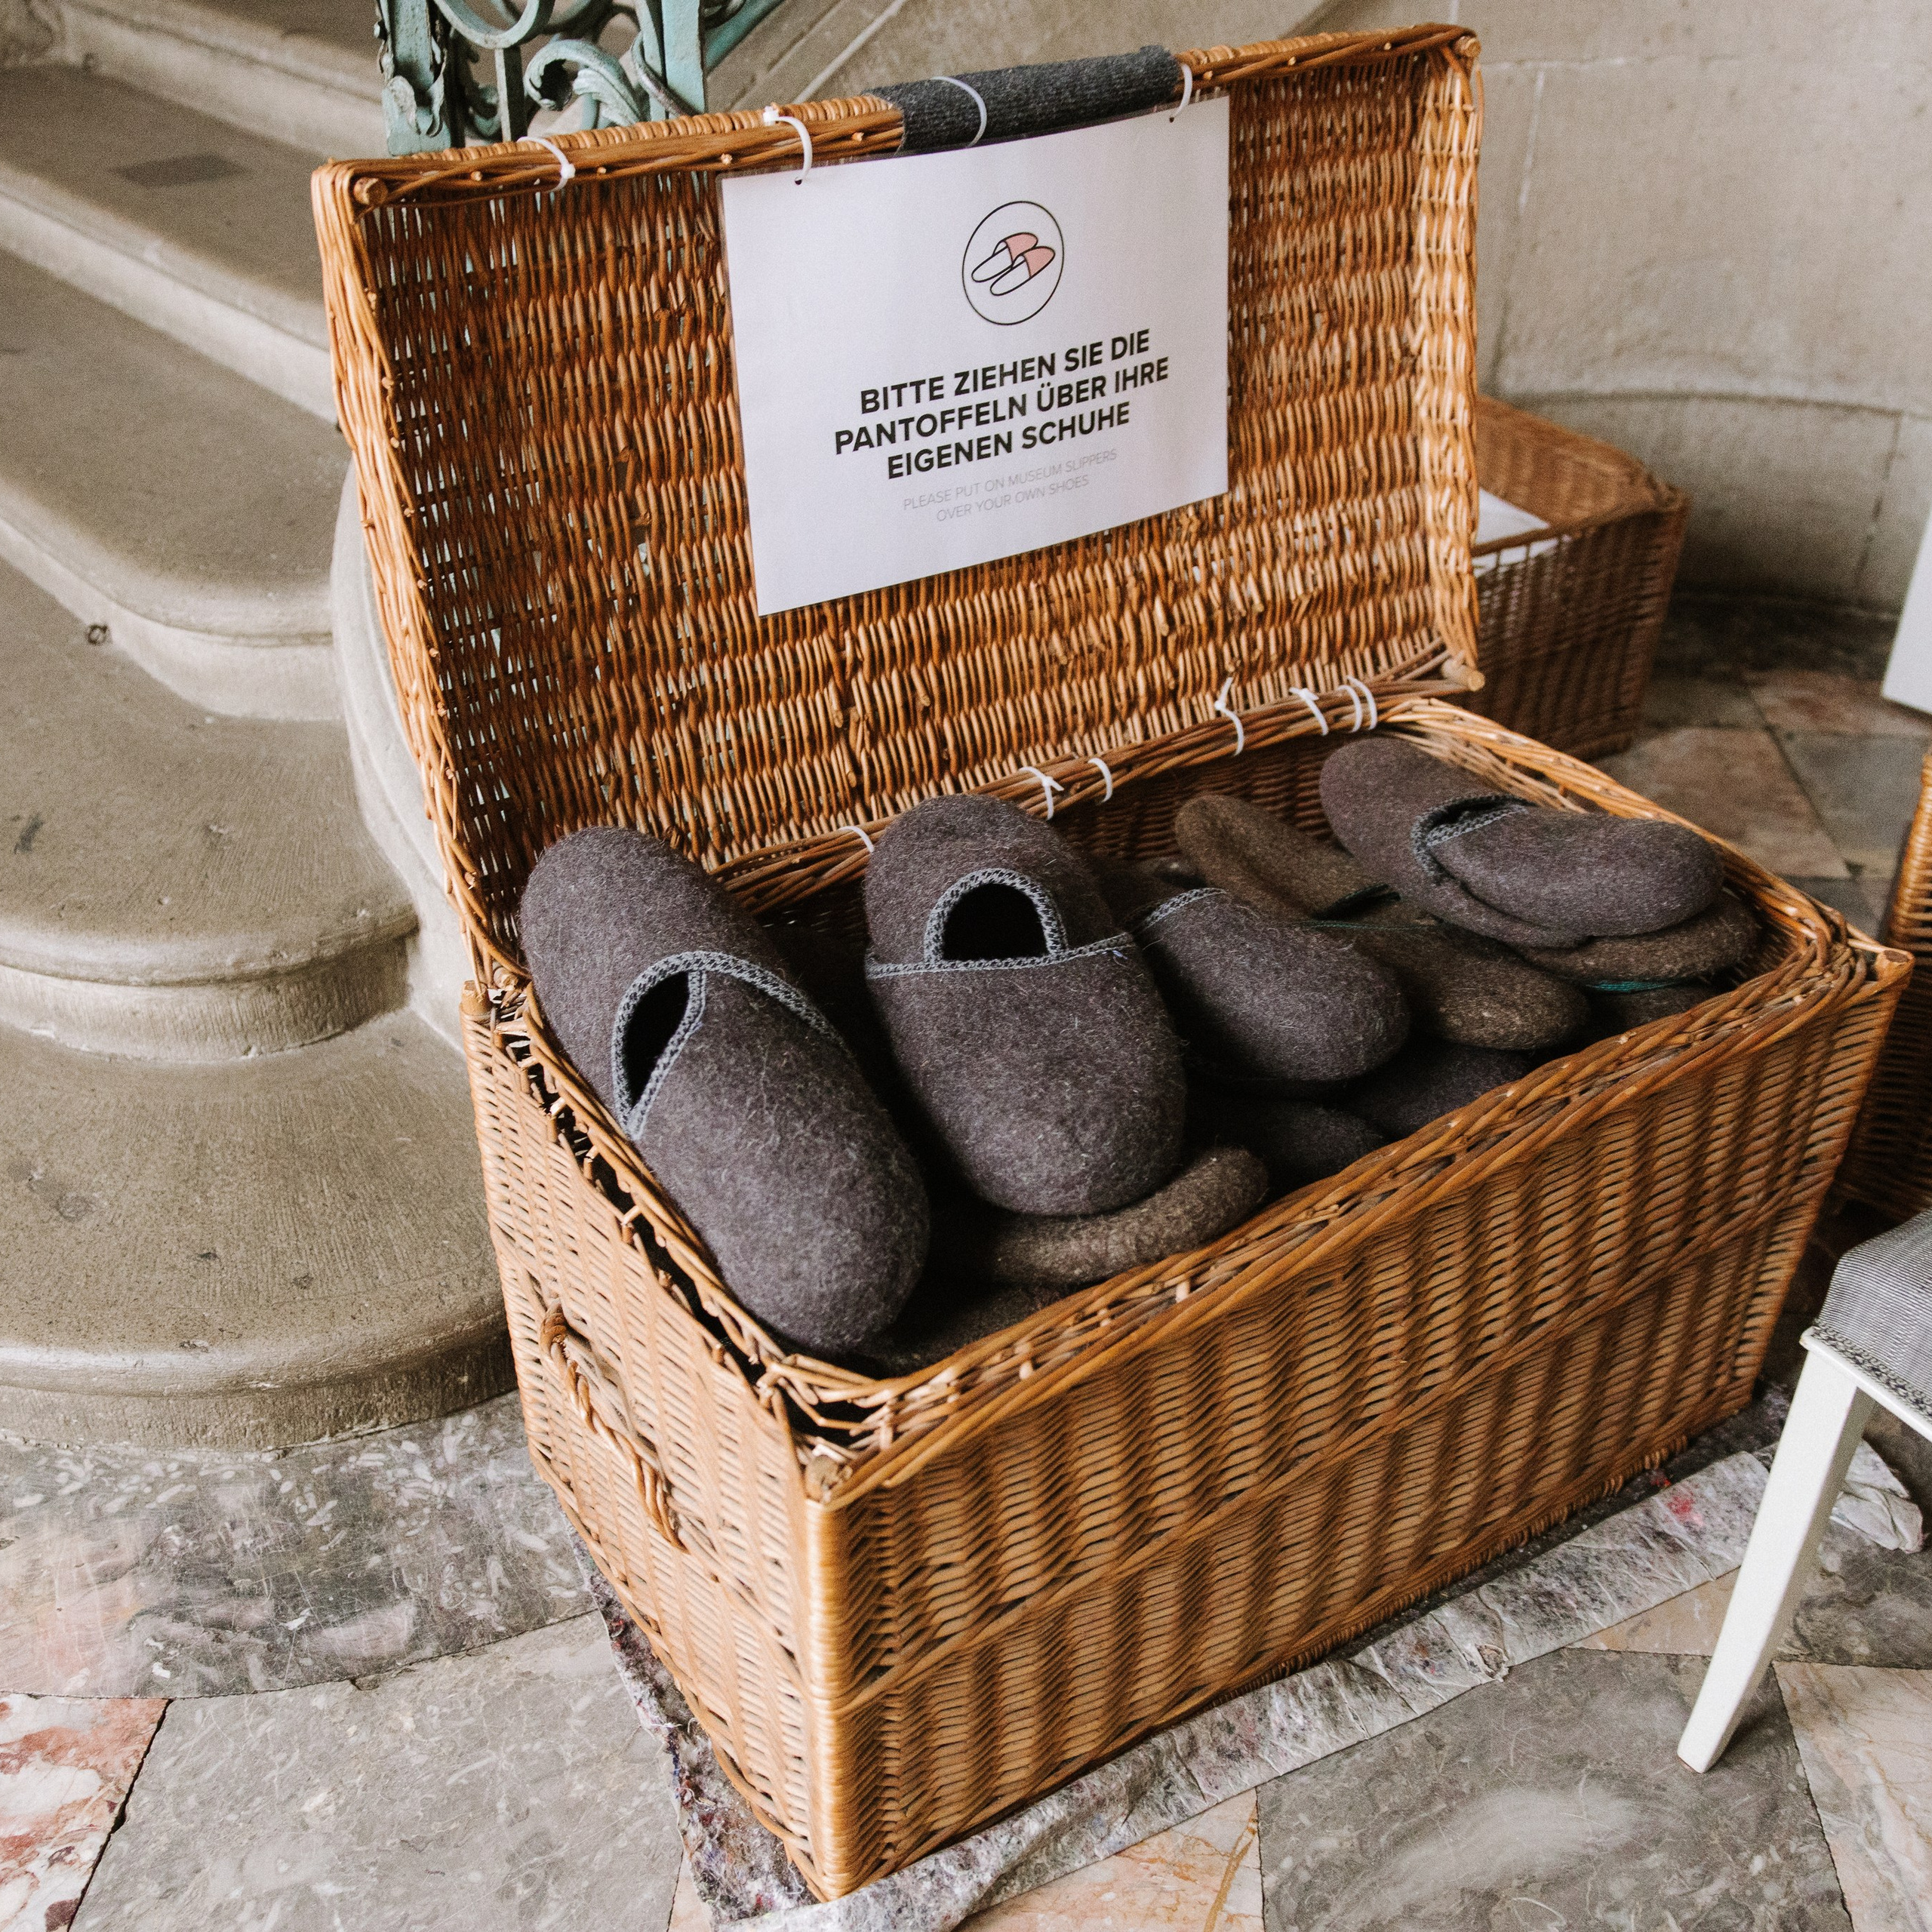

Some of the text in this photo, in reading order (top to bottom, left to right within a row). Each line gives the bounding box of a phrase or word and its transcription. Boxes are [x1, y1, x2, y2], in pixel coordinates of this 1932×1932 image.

[835, 357, 1169, 454] PANTOFFELN ÜBER IHRE
[861, 328, 1150, 414] BITTE ZIEHEN SIE DIE
[888, 401, 1130, 479] EIGENEN SCHUHE
[903, 449, 1117, 511] PLEASE PUT ON MUSEUM SLIPPERS
[937, 475, 1089, 521] OVER YOUR OWN SHOES
